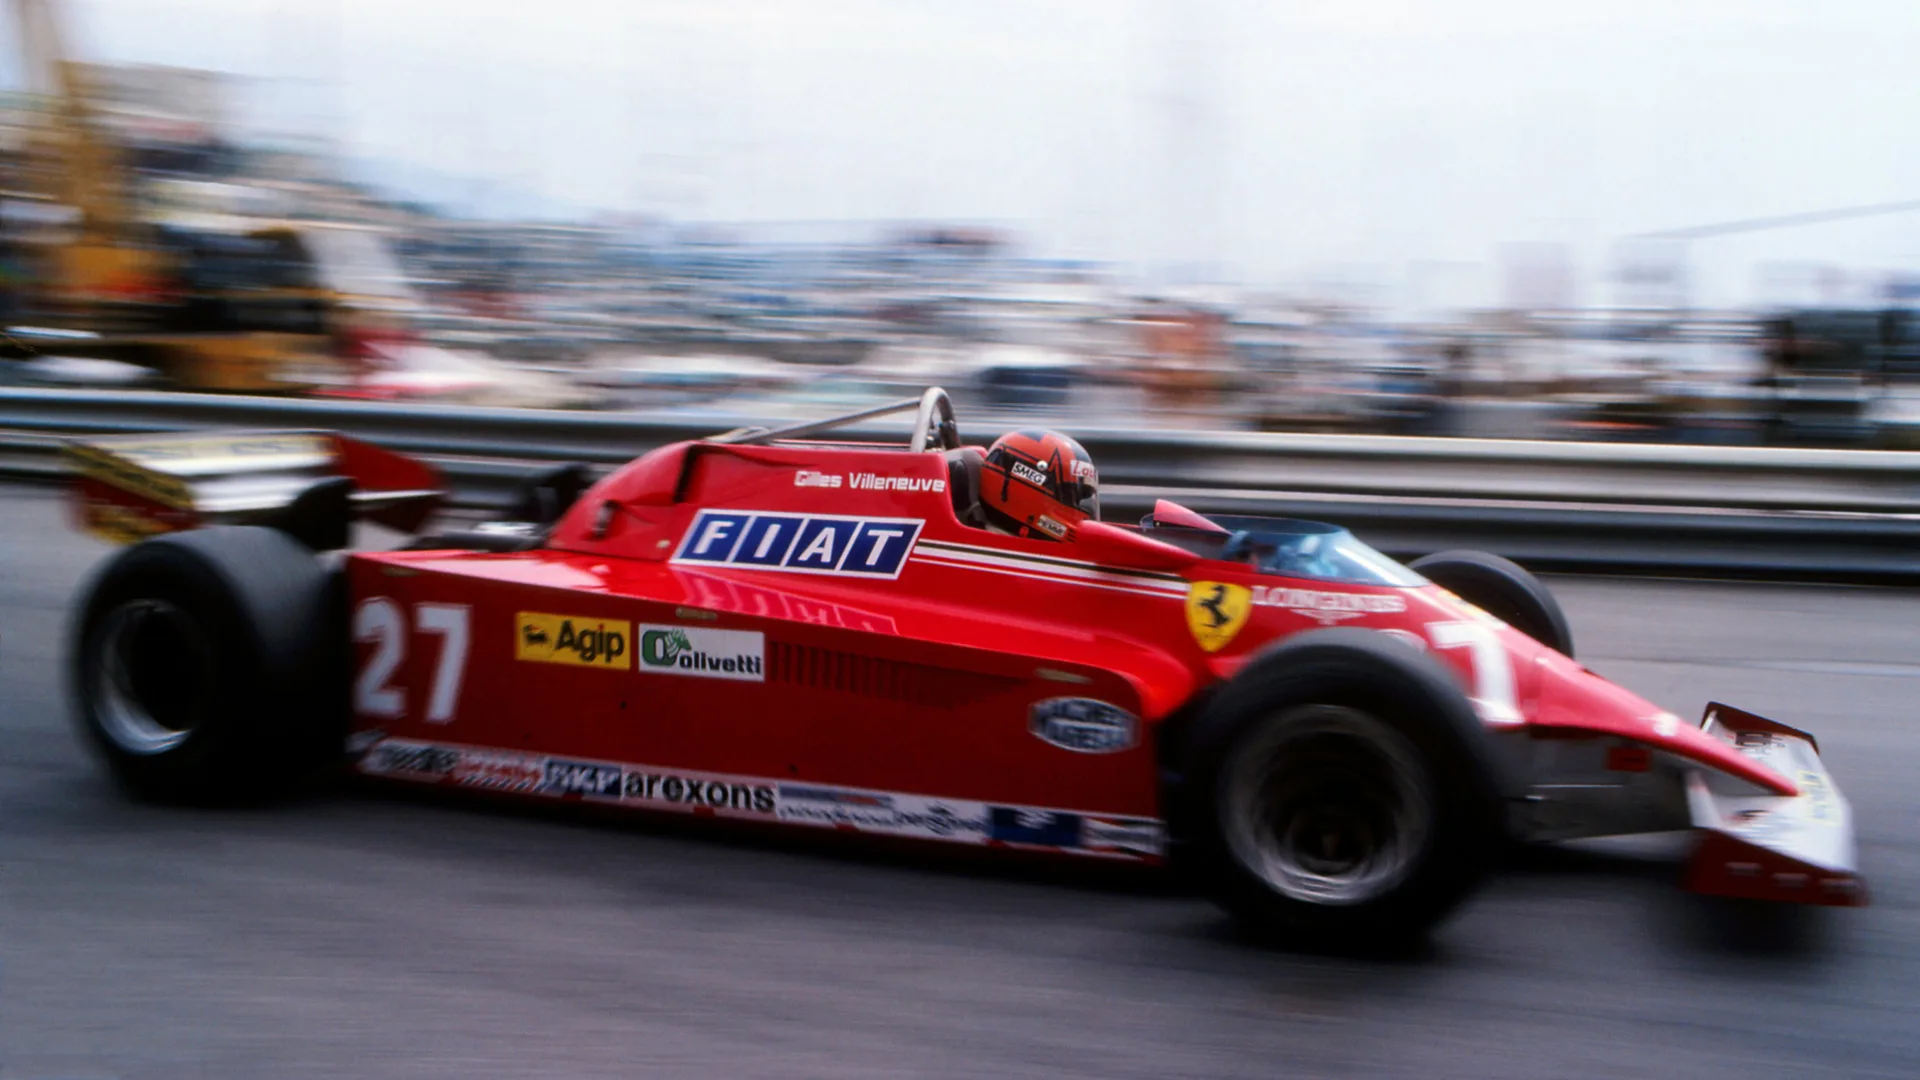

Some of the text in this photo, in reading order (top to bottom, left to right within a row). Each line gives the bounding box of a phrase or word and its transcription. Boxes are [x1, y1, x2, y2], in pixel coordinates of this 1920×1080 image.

[794, 469, 945, 493] Gilles Villeneuve
[1012, 463, 1044, 484] SMEG
[692, 519, 905, 567] FIAT
[1251, 585, 1407, 613] LONGINES
[351, 596, 472, 724] 27
[555, 619, 625, 664] Agip
[624, 773, 776, 812] arexons
